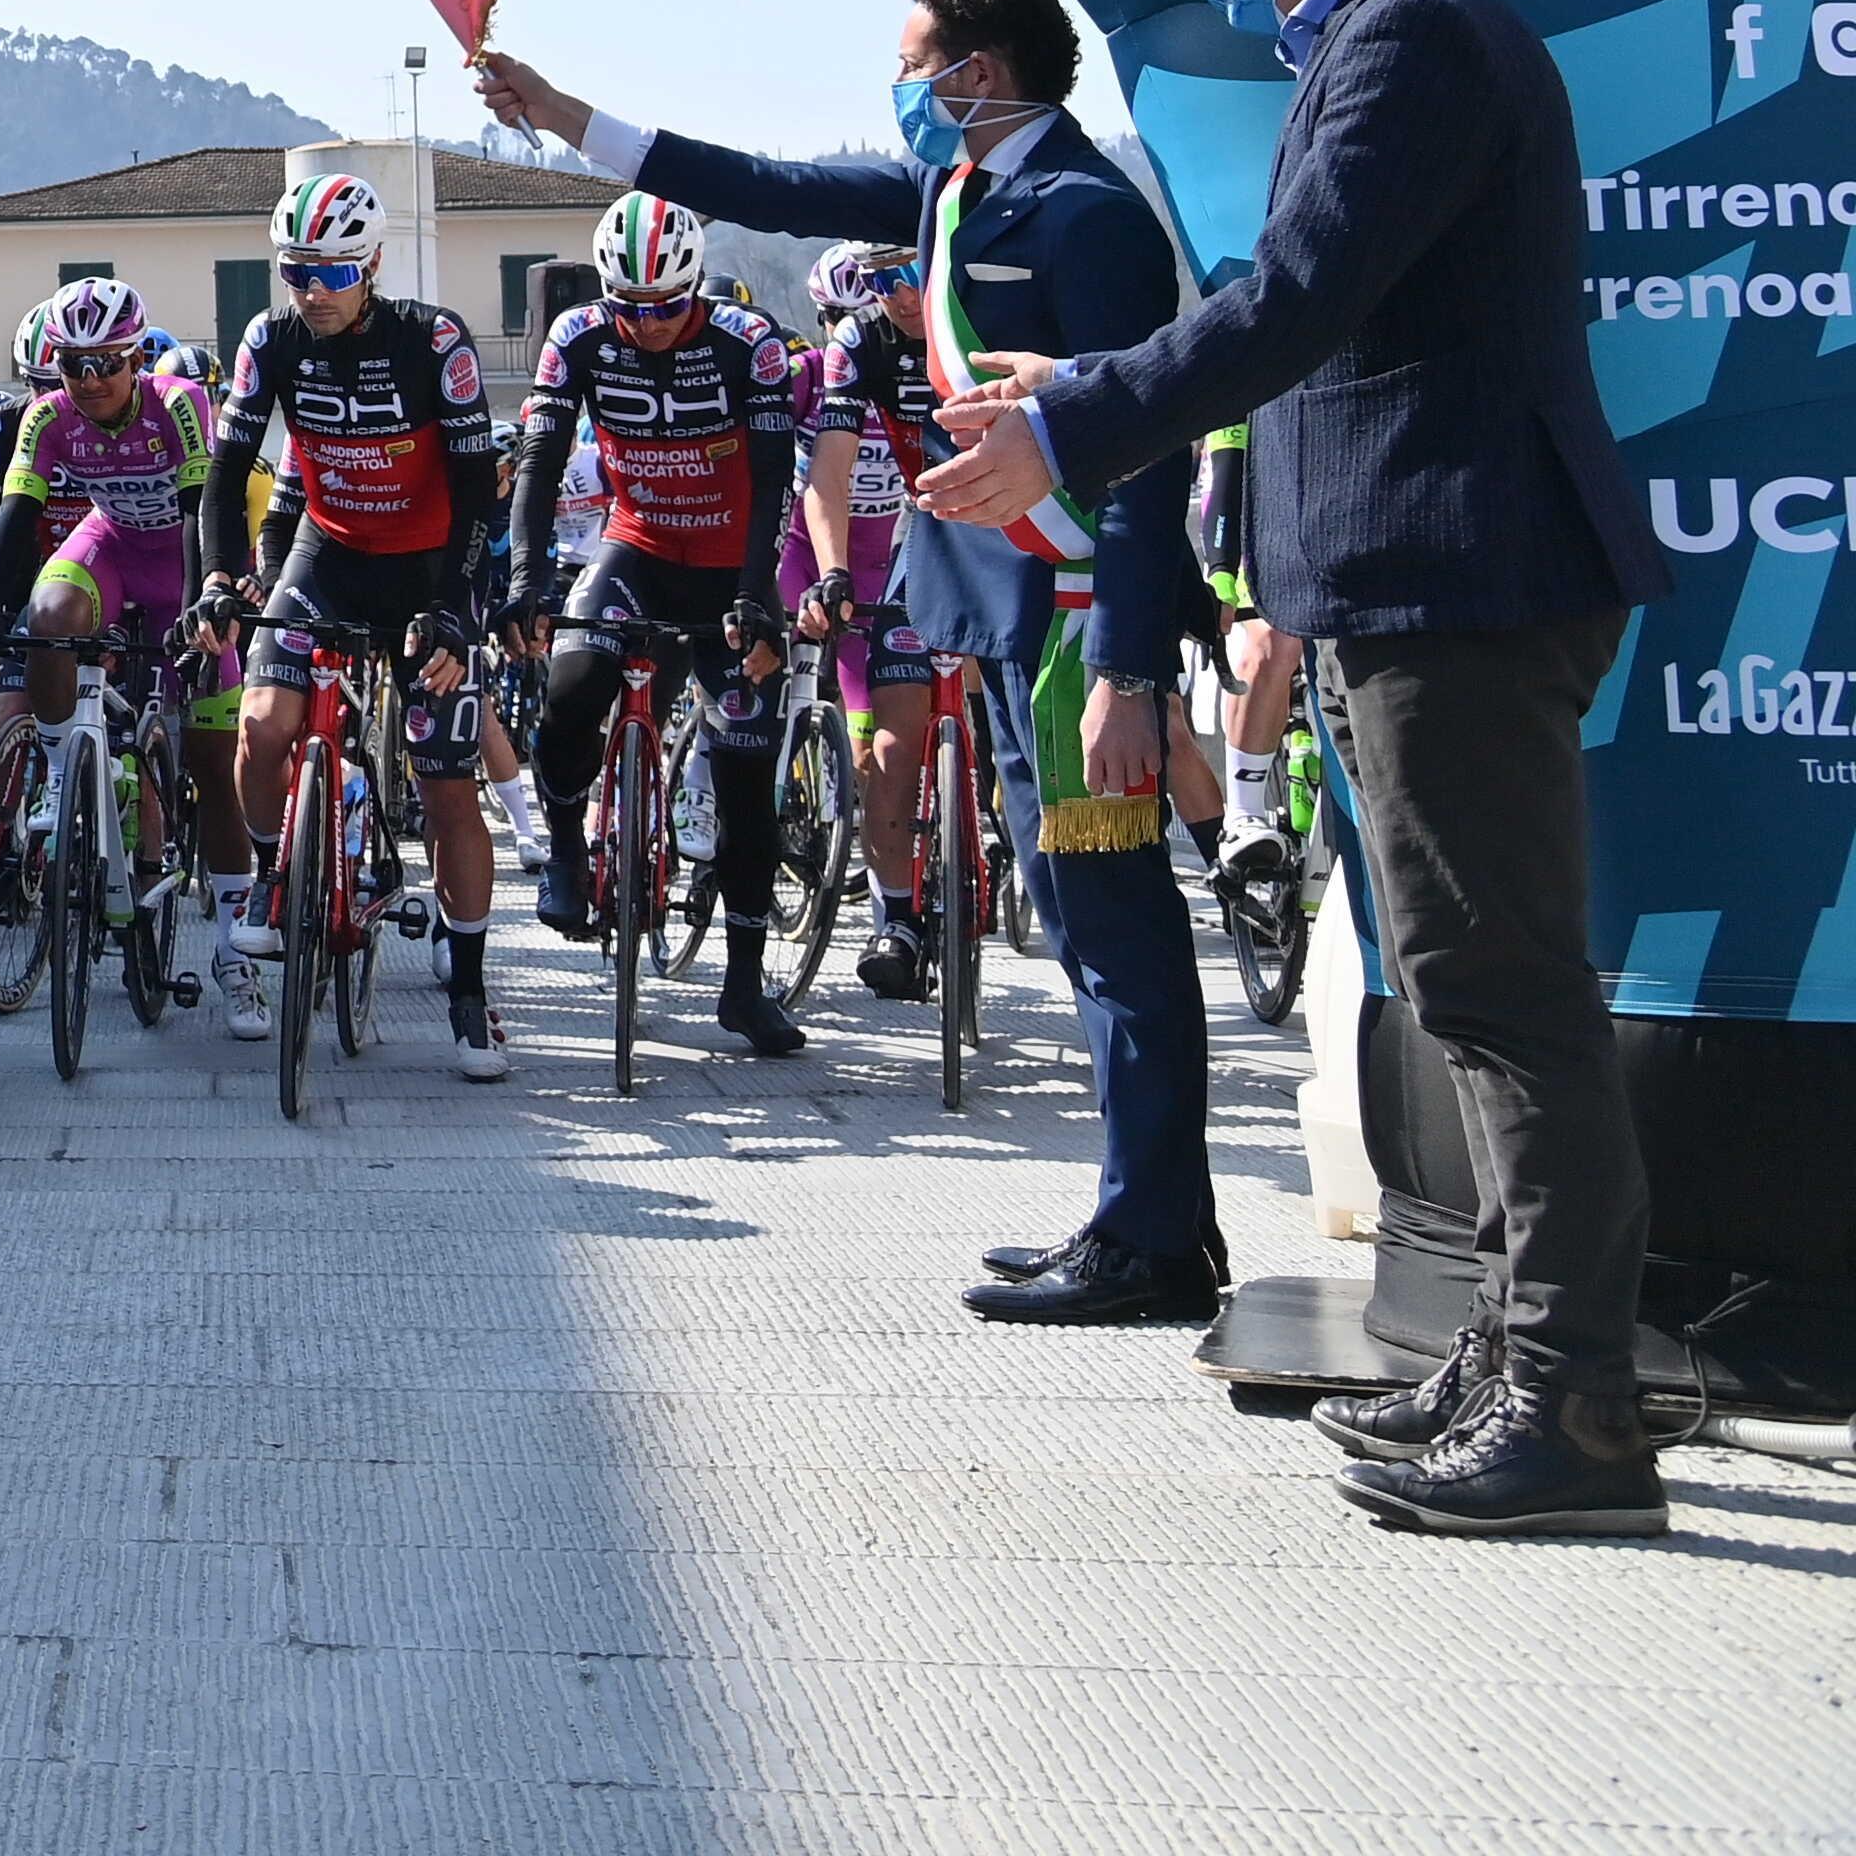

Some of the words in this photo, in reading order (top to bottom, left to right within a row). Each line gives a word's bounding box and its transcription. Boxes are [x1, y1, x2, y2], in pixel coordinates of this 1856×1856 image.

[364, 381, 396, 393] UCLM
[681, 373, 723, 388] UCLM
[294, 390, 404, 423] DH
[594, 385, 729, 424] DH
[295, 419, 343, 435] DRONE
[345, 422, 413, 436] HOPPER
[319, 443, 381, 458] ANDRONI
[623, 447, 702, 462] ANDRONI
[313, 453, 393, 470] GIOCATTOLI
[616, 461, 715, 478] GIOCATTOLI
[259, 663, 308, 685] LAURETAN
